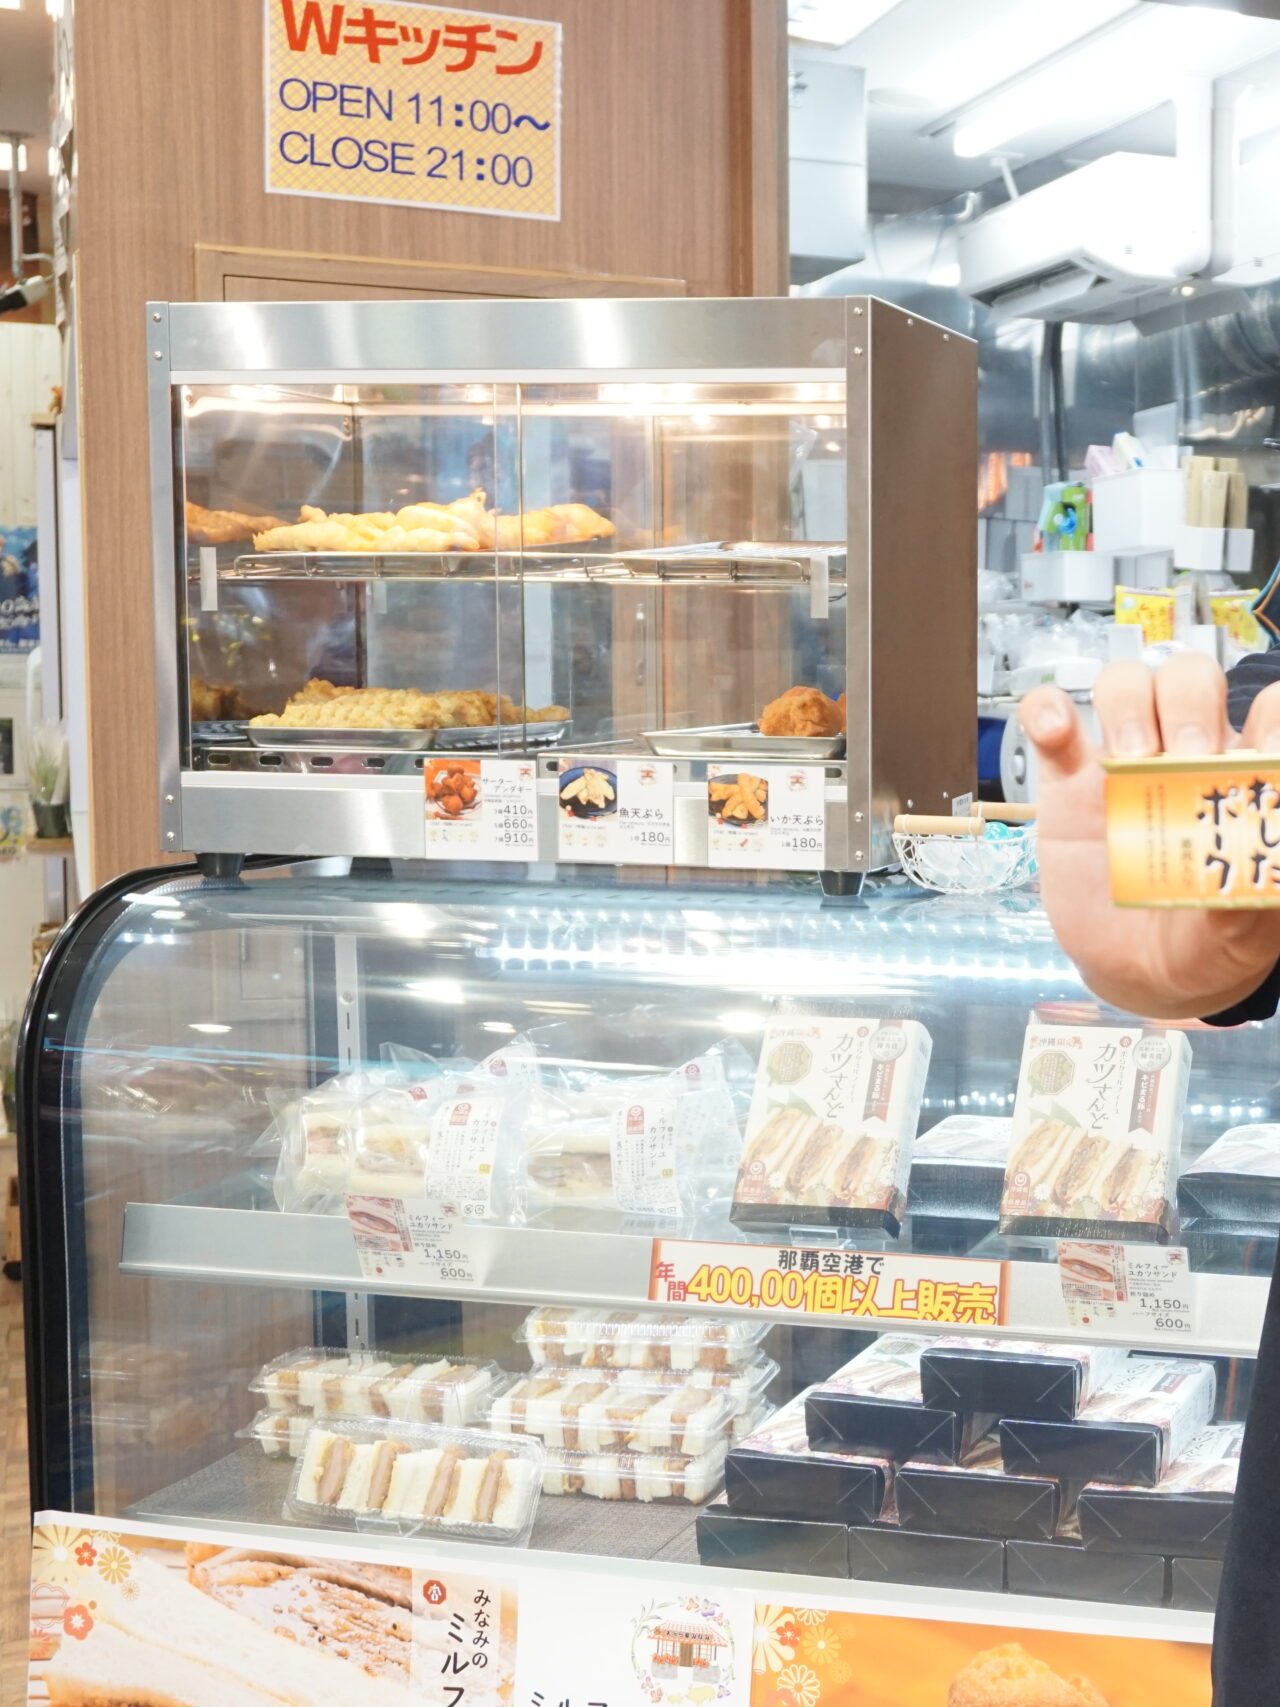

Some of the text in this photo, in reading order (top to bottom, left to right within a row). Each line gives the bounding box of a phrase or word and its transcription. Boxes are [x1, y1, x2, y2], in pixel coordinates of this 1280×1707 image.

[281, 0, 543, 76] Wキッチン
[279, 78, 393, 122] OPEN
[279, 131, 533, 188] CLOSE 21:00
[1197, 785, 1240, 890] ポーク
[822, 1033, 855, 1119] カツさんど
[1085, 1042, 1117, 1130] カツさんど
[778, 1250, 885, 1276] 那覇空港で
[441, 1612, 470, 1707] ミルフ
[472, 1589, 492, 1669] みなみの
